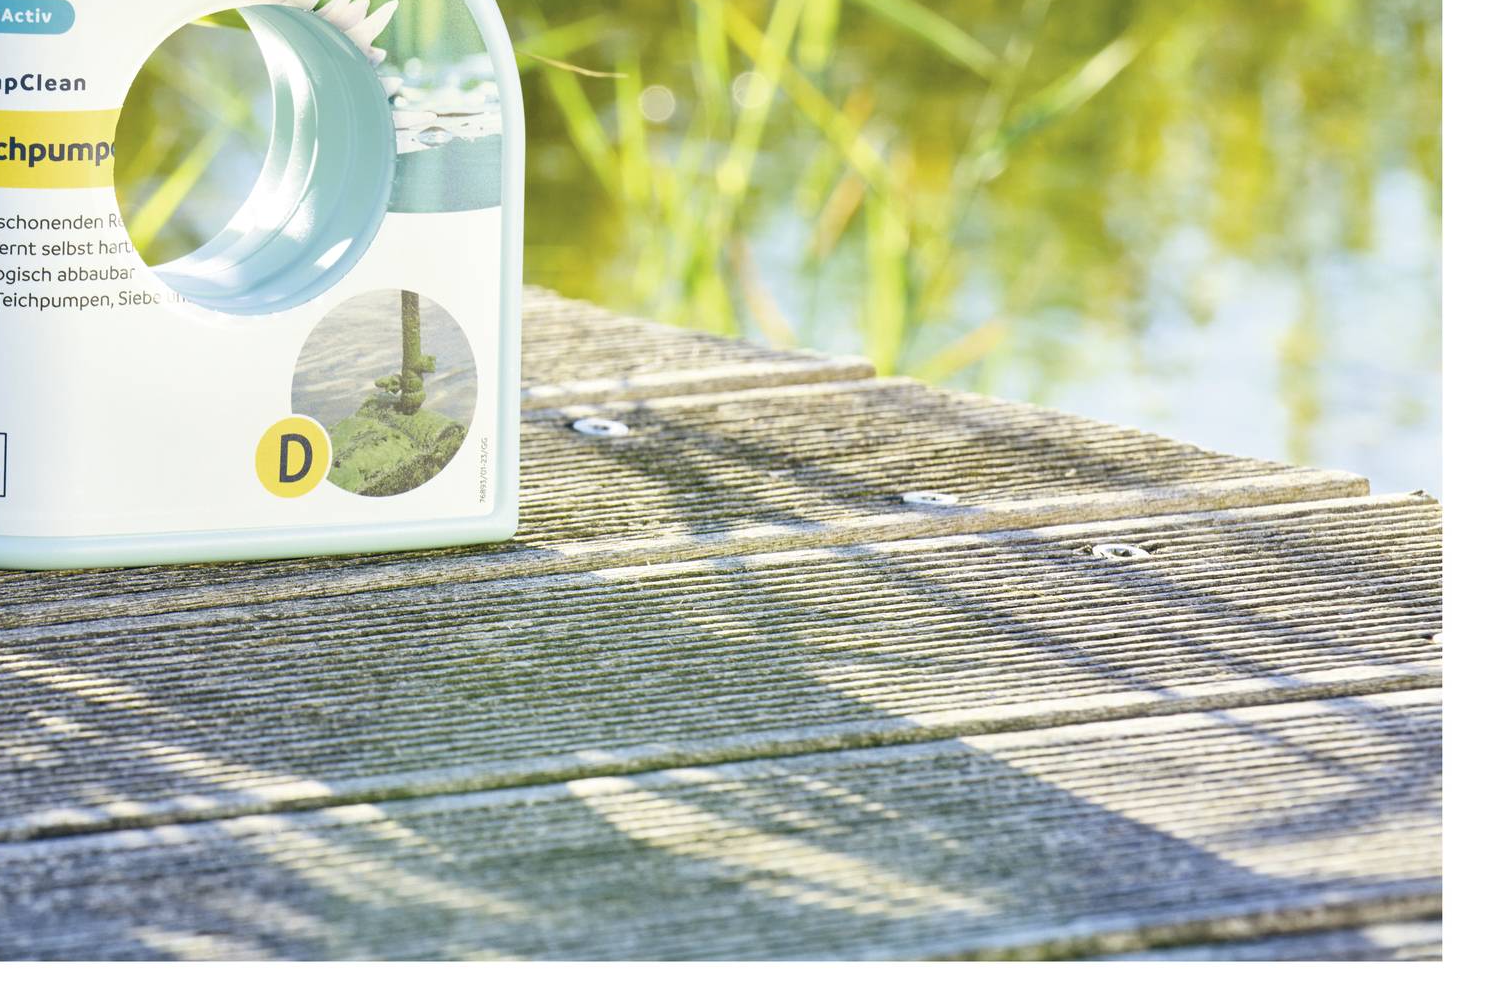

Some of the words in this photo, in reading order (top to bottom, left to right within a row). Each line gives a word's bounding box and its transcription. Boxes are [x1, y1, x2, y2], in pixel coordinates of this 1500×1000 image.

[41, 240, 94, 256] selbst
[57, 265, 136, 282] abbaubar
[118, 290, 162, 306] Siebe
[279, 433, 313, 482] D
